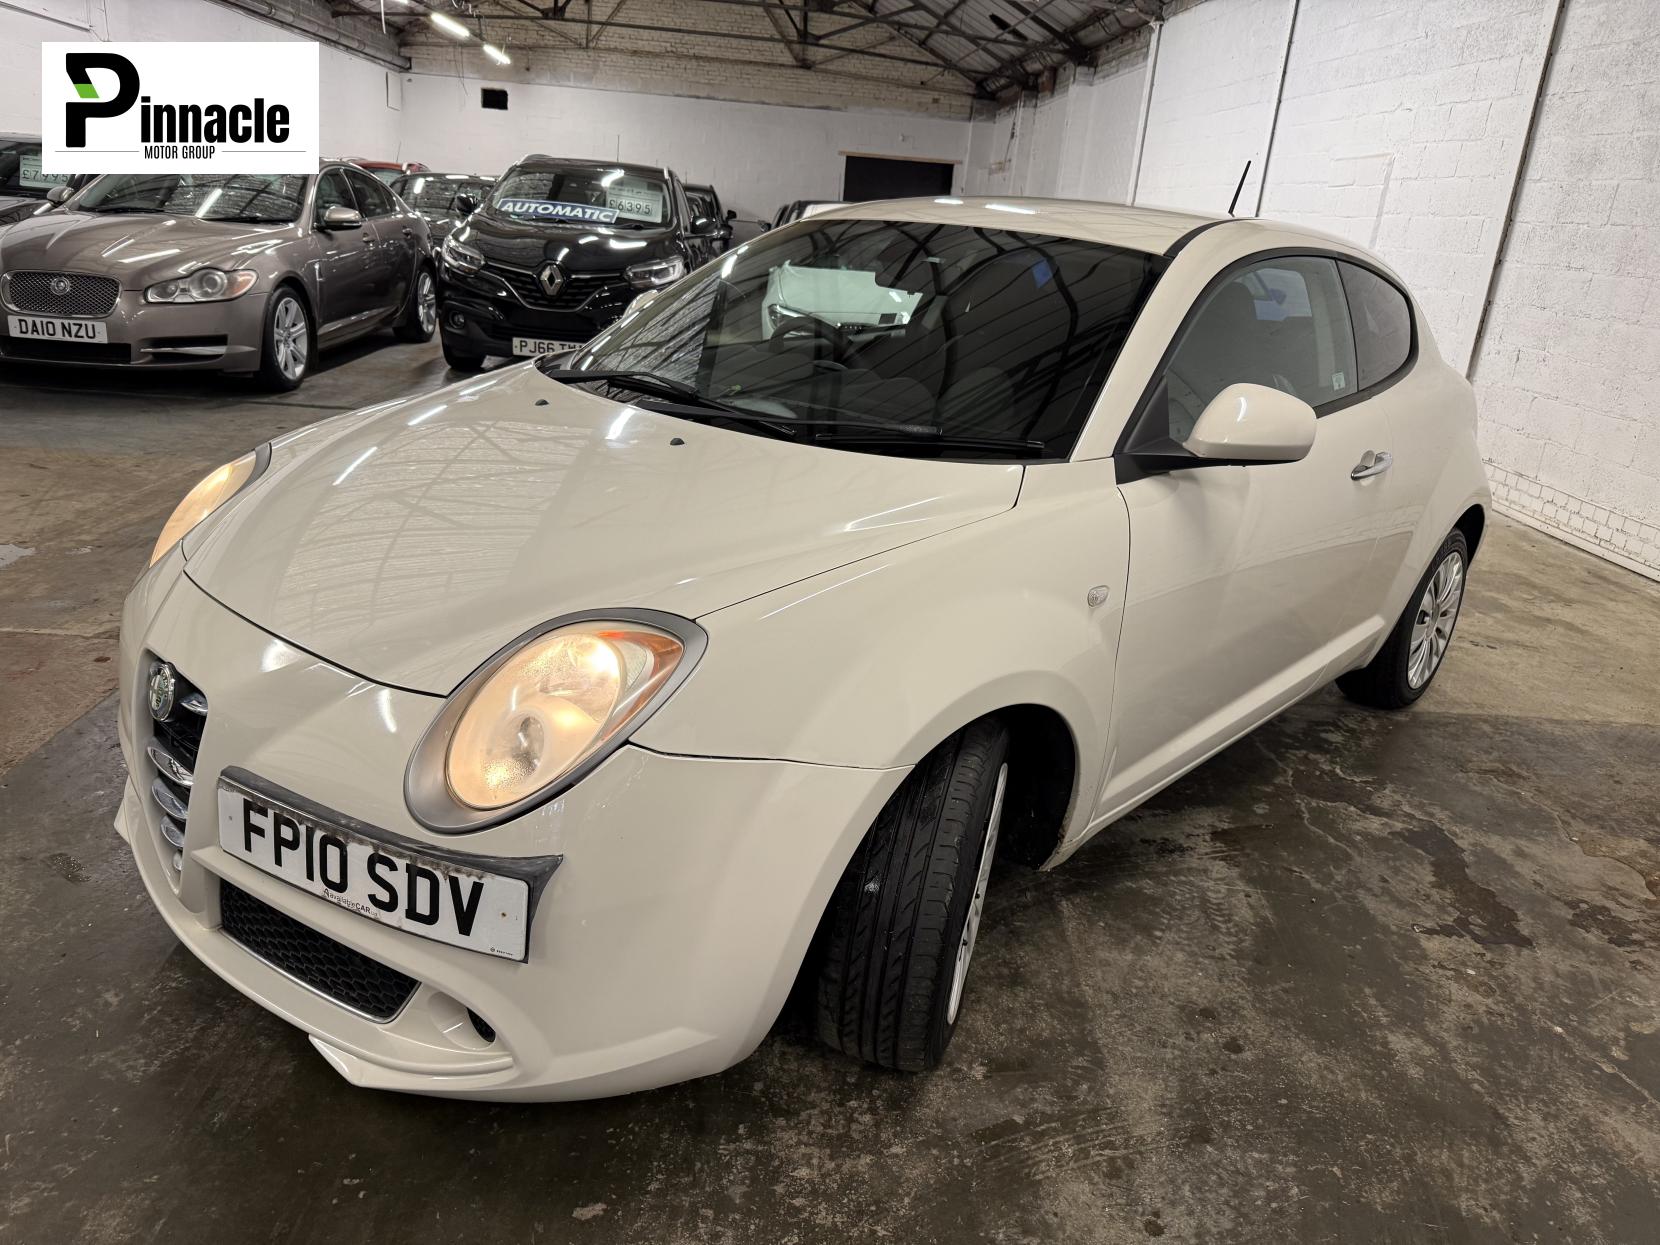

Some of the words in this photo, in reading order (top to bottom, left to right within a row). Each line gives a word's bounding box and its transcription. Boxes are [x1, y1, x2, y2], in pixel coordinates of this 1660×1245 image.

[501, 202, 613, 222] AUTOMATIC
[18, 318, 57, 337] DA10
[61, 321, 97, 339] NZU
[519, 340, 555, 354] PJ66
[243, 797, 348, 894] FP10
[367, 851, 485, 937] SDV
